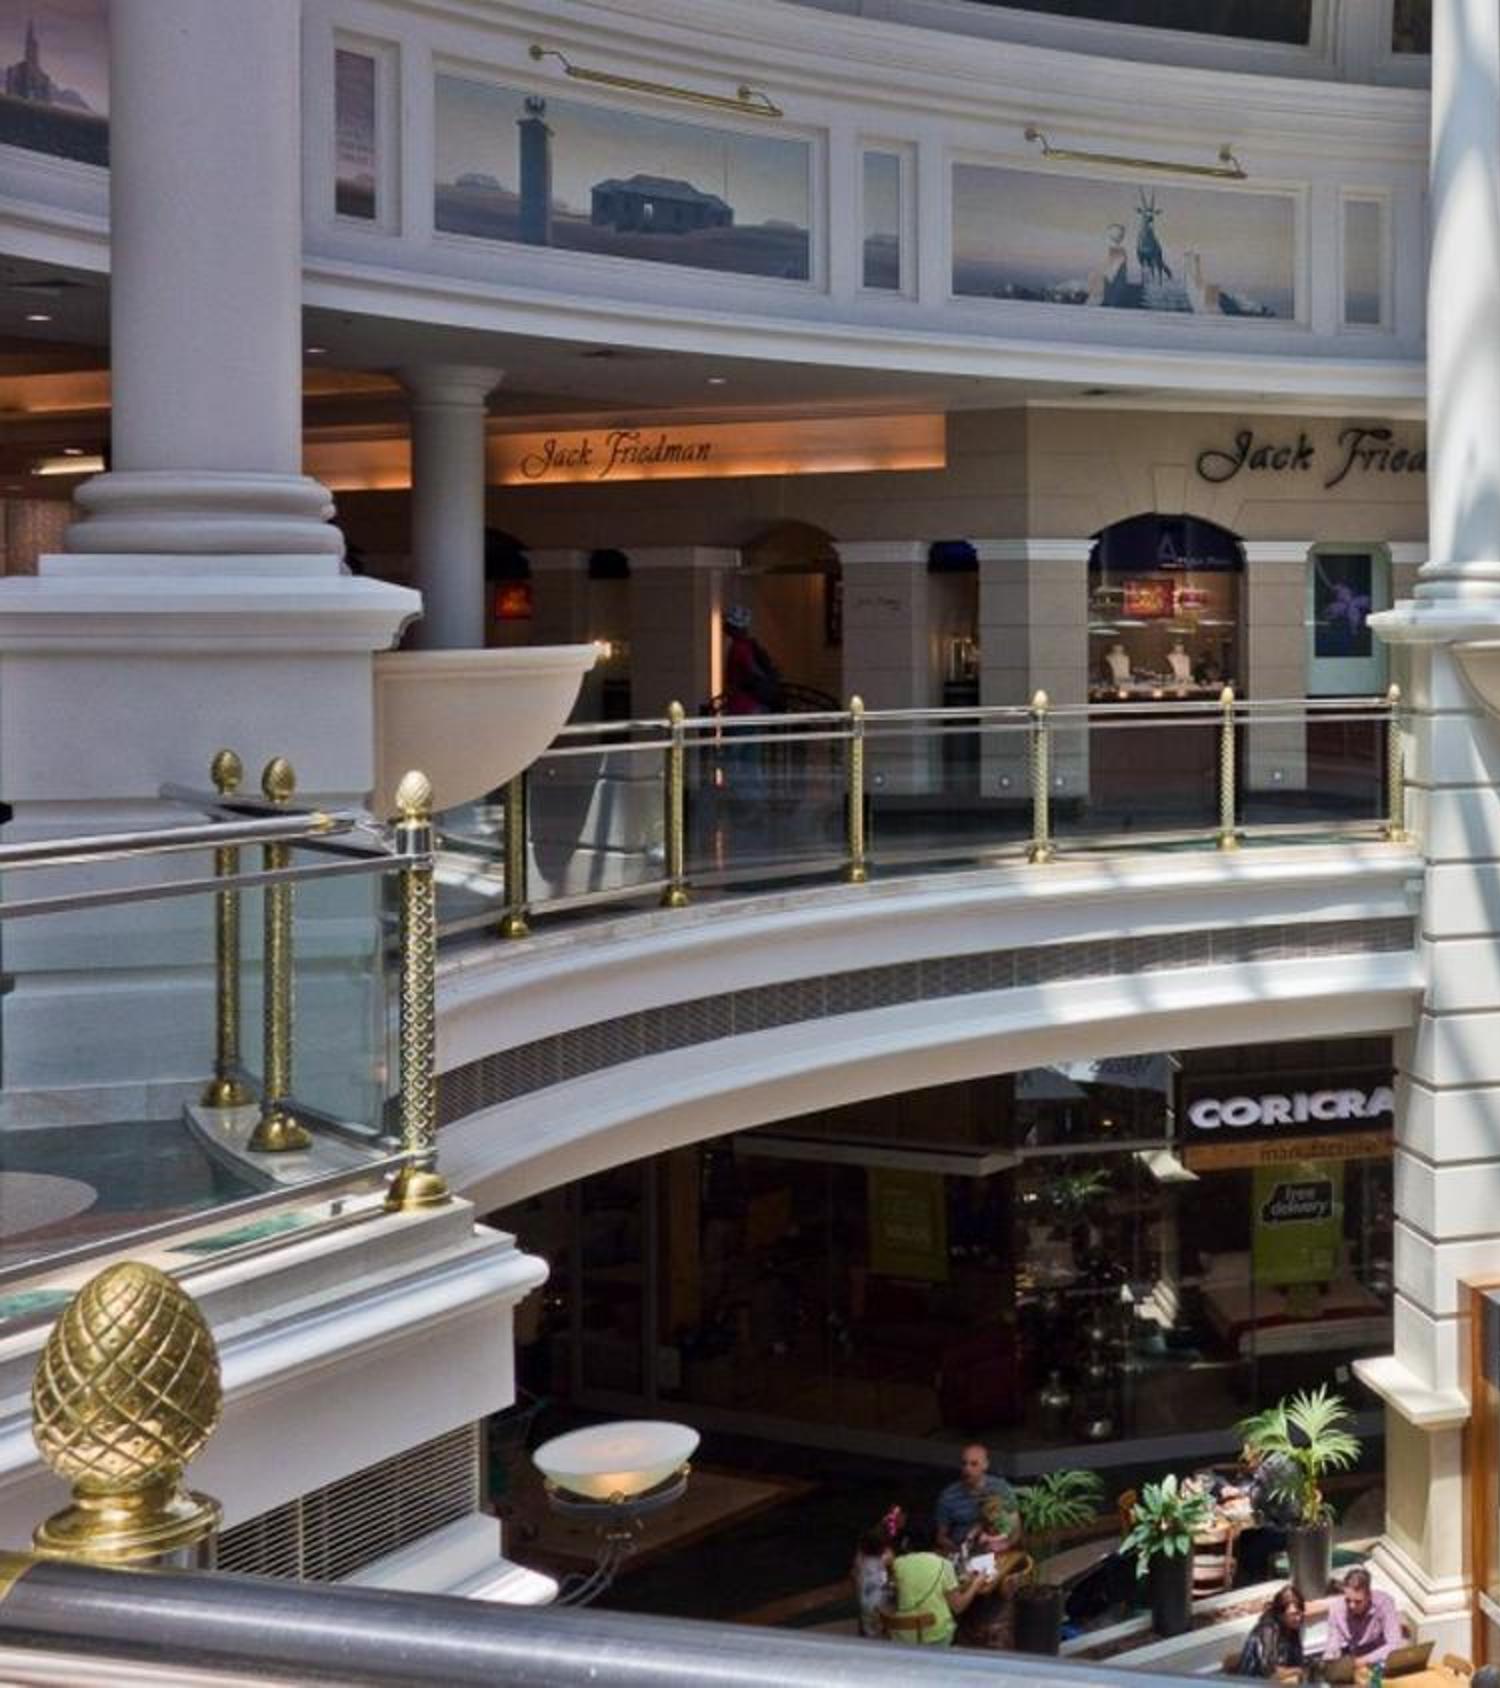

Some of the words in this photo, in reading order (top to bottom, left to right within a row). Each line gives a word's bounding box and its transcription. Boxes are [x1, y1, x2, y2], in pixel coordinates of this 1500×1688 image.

[520, 438, 594, 479] Jack
[598, 431, 711, 478] Friedman
[1197, 430, 1315, 483] Jack
[1188, 1086, 1393, 1129] CORICRA
[1271, 1197, 1329, 1216] delivery
[1285, 1184, 1317, 1201] free
